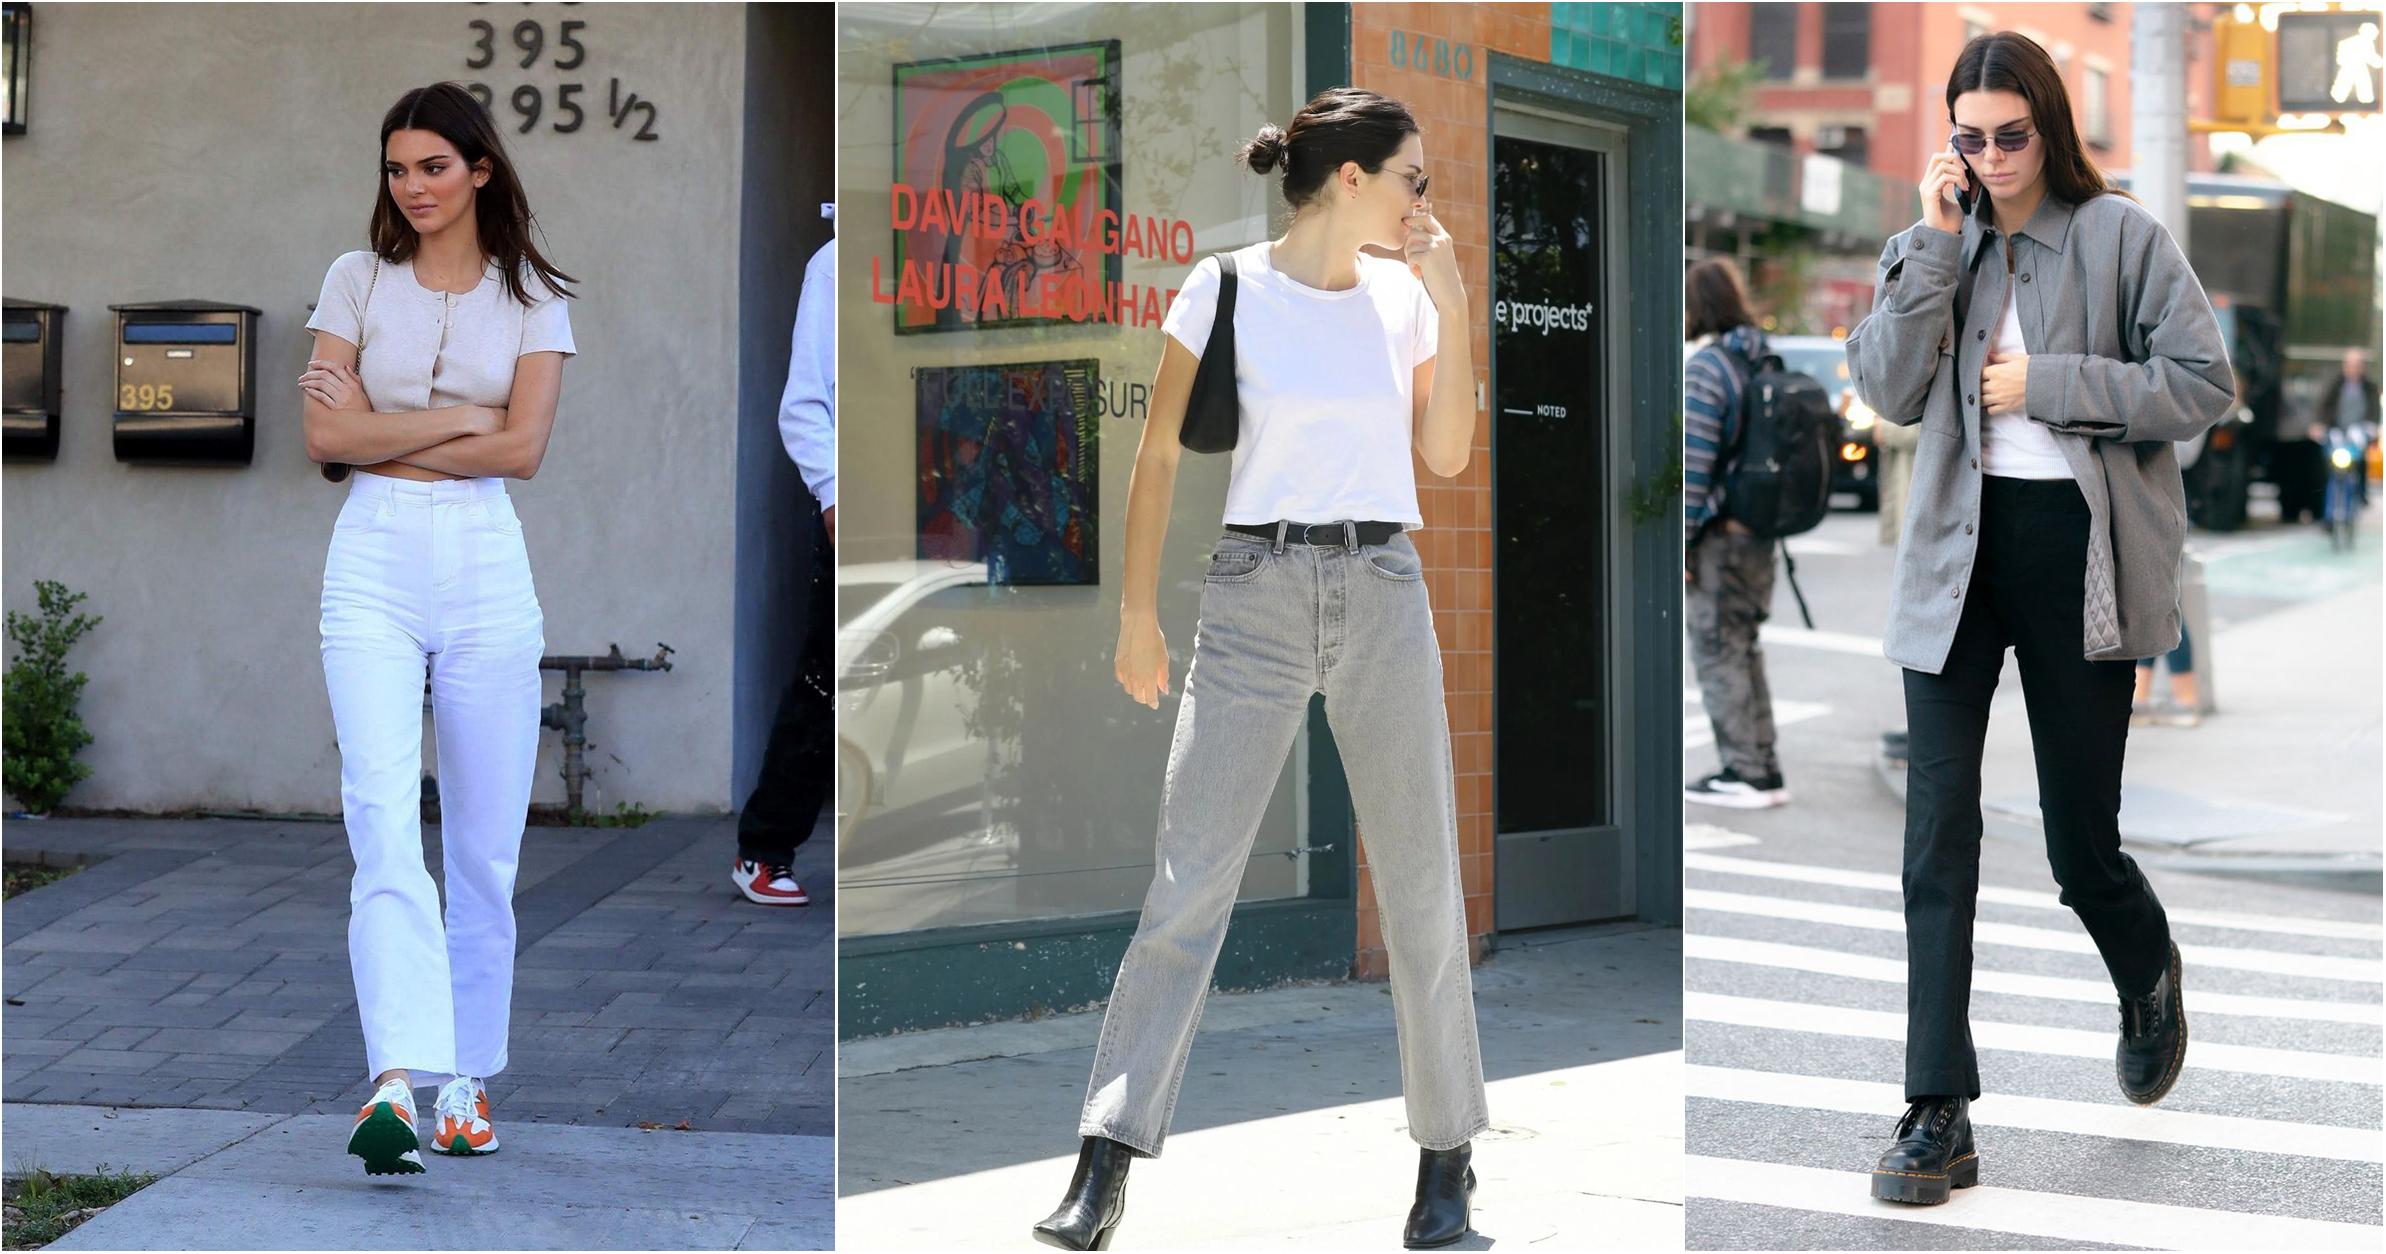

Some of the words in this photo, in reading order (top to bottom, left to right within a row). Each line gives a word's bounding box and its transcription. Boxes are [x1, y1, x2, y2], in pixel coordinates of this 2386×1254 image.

[466, 19, 586, 70] 395
[1391, 29, 1472, 80] 8680
[891, 183, 1007, 239] DAVID
[1019, 198, 1195, 266] GALGANO
[872, 256, 1010, 316] LAURA
[120, 383, 174, 411] 395
[1537, 404, 1567, 418] NOTED
